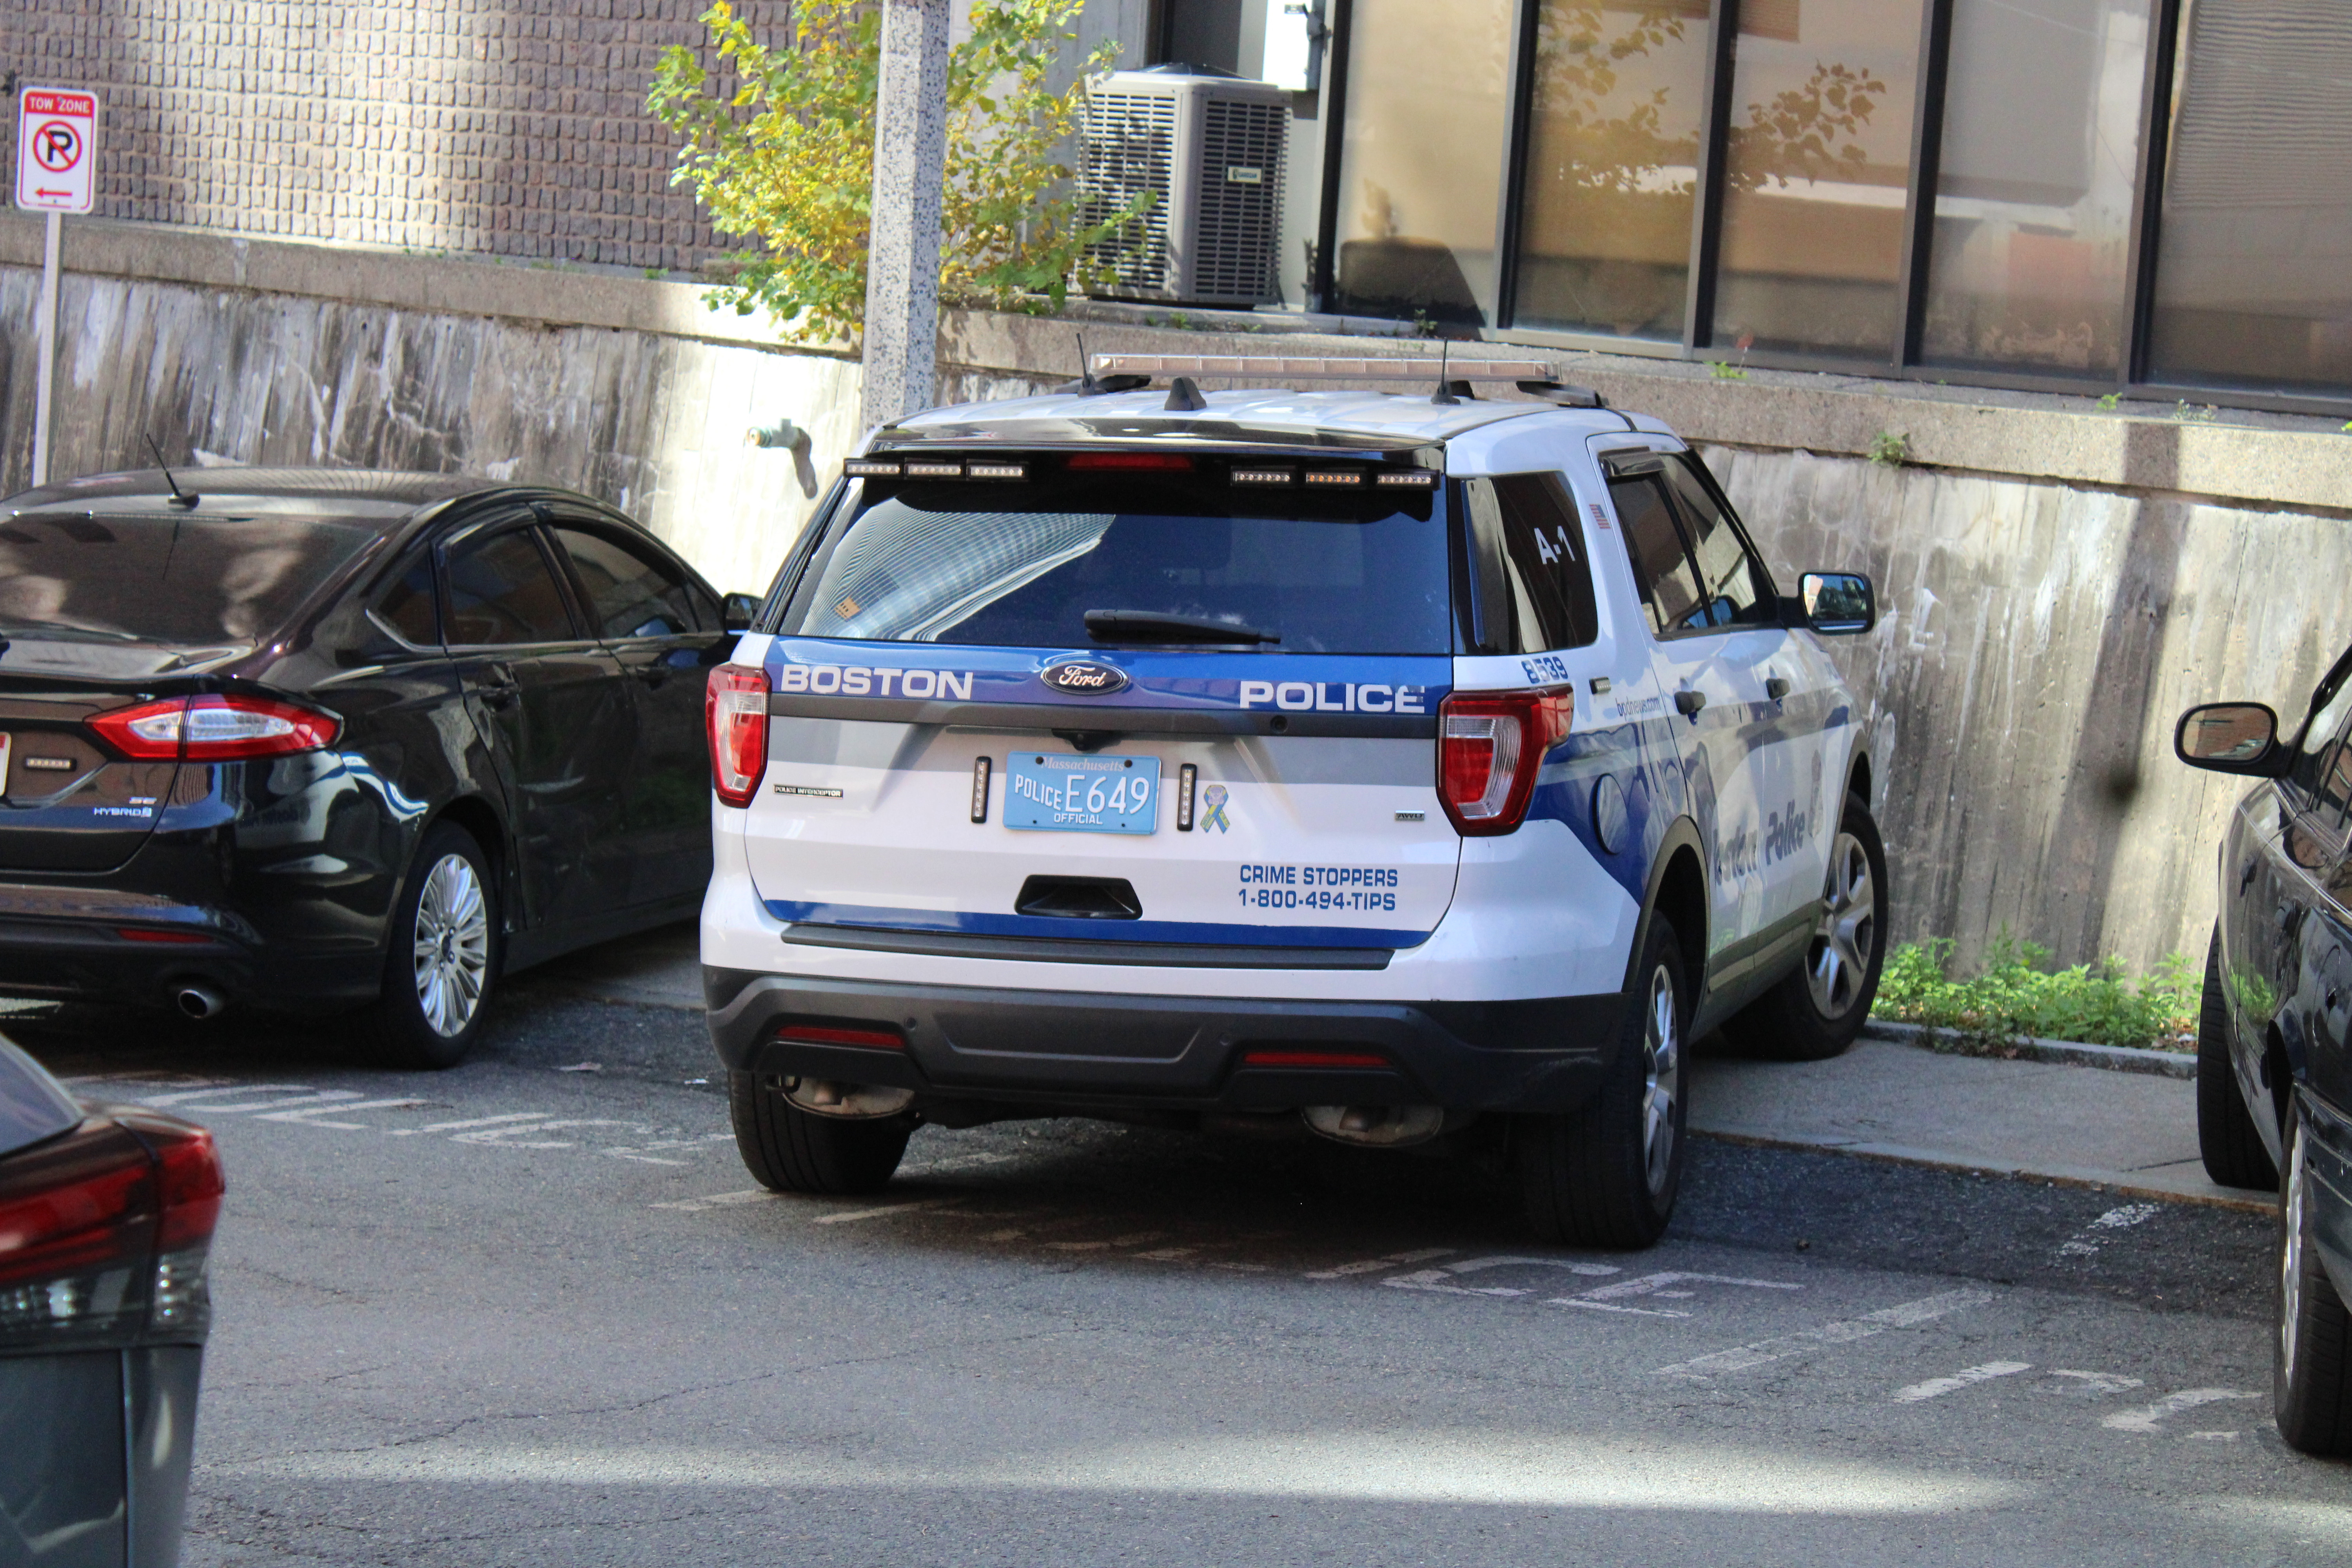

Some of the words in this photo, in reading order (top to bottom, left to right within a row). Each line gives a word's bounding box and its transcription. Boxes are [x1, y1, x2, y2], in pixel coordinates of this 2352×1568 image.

[30, 96, 54, 111] TOW
[58, 97, 90, 113] ZONE
[1534, 525, 1575, 564] A-1
[781, 664, 973, 699] BOSTON
[1059, 665, 1107, 686] Ford
[1521, 657, 1568, 684] 8539
[1240, 681, 1425, 713] POLICE
[1615, 696, 1661, 722] bpdnews.com
[1042, 757, 1124, 771] Massachusetts
[797, 788, 840, 797] INTERCEPTOR
[1015, 774, 1062, 811] POLICE
[1065, 775, 1149, 814] E649
[93, 807, 142, 816] HYBRID
[1054, 813, 1103, 825] OFFICIAL
[1765, 799, 1805, 865] Police
[1240, 864, 1296, 884] CRIME
[1303, 867, 1397, 887] STOPPERS
[1238, 889, 1396, 911] 1-800-494-TIPS
